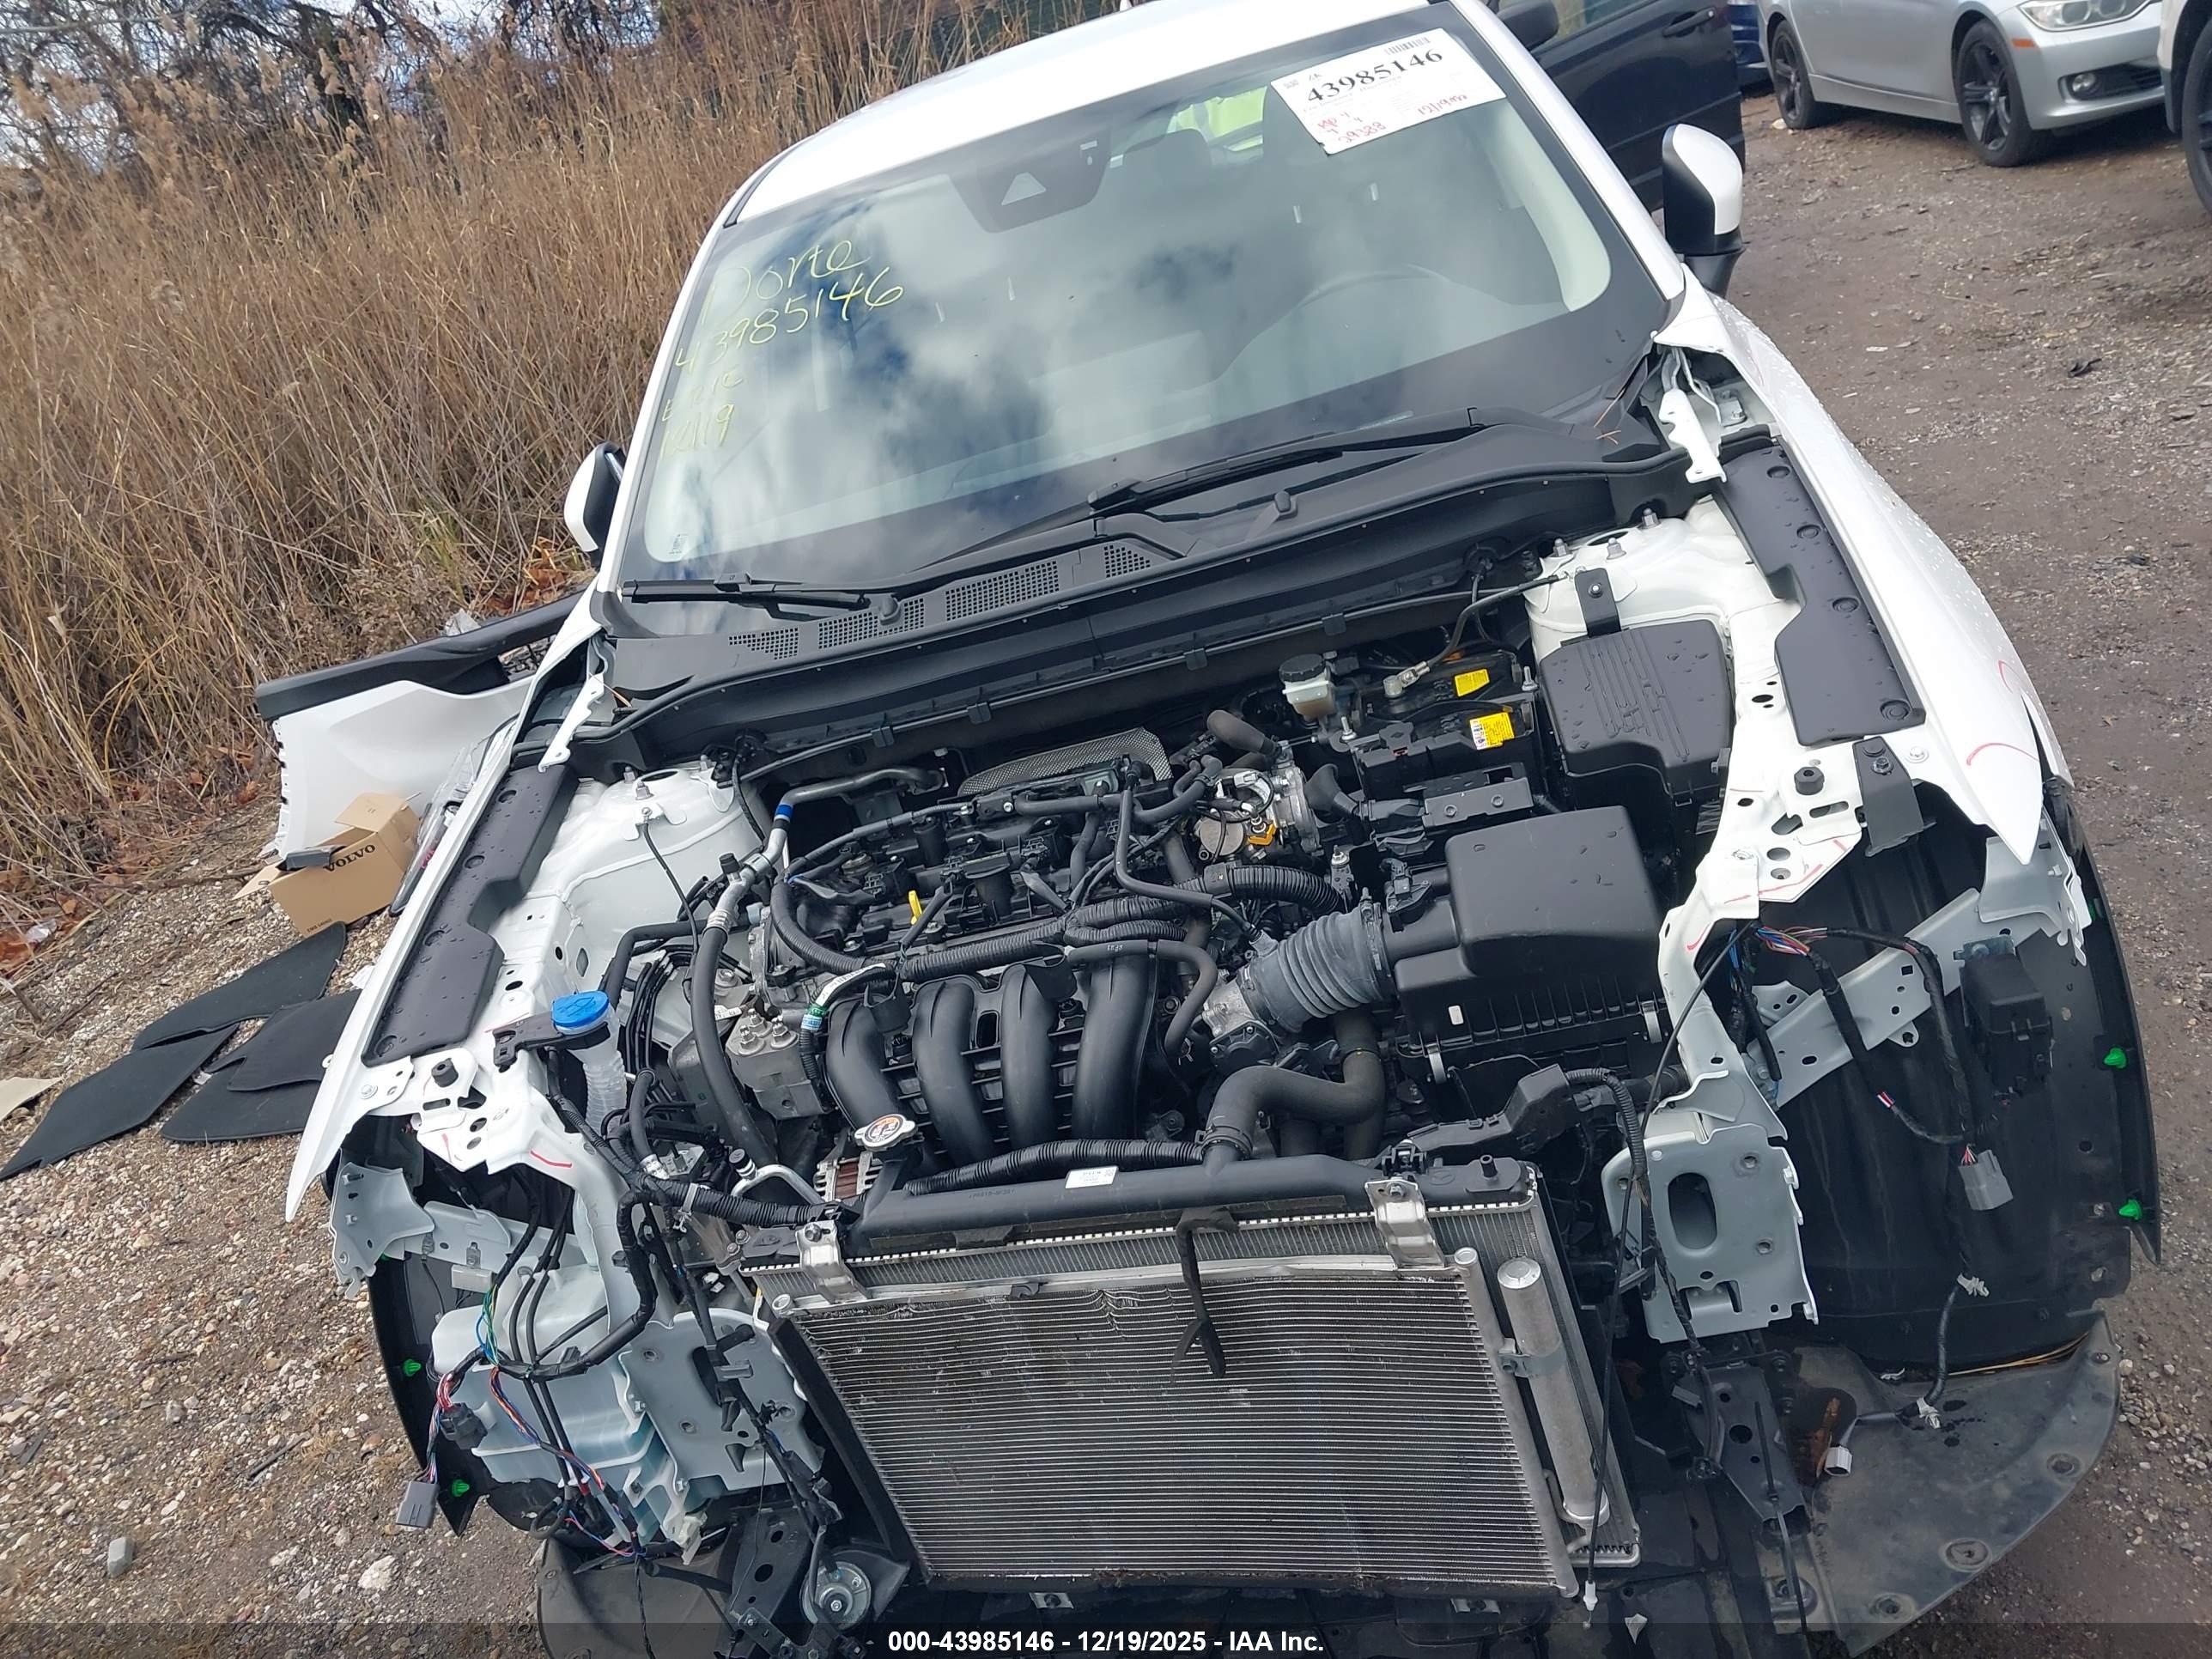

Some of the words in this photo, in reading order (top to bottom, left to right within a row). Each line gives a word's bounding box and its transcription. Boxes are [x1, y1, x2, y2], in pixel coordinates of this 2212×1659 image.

[1308, 49, 1443, 102] 43985146
[675, 267, 904, 373] 43985146
[323, 844, 376, 872] VOLVO
